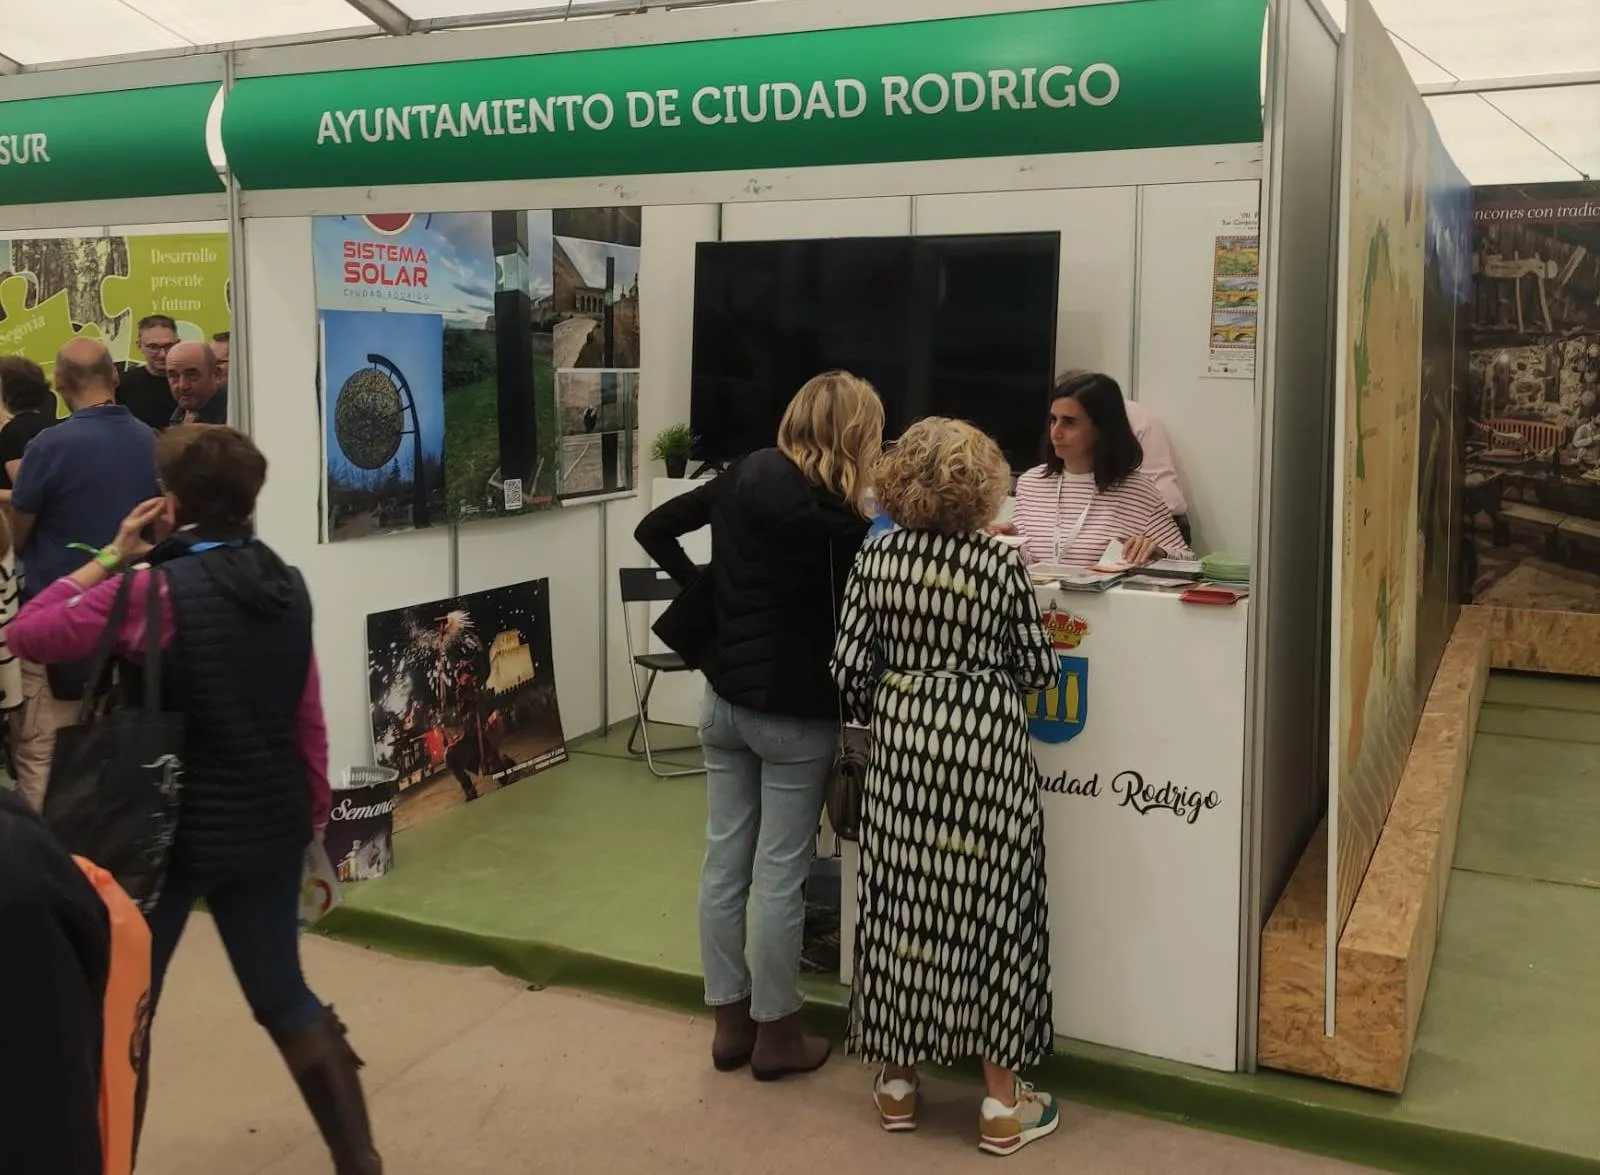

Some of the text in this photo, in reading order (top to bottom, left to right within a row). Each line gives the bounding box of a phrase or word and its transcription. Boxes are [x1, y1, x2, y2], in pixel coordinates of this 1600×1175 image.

[316, 63, 1121, 146] AYUNTAMIENTO DE CIUDAD RODRIGO
[0, 132, 50, 165] SUR
[1527, 207, 1554, 218] con
[151, 248, 217, 264] Desarrollo
[343, 240, 428, 265] SISTEMA
[151, 273, 205, 292] presente
[343, 261, 428, 288] SOLAR
[161, 296, 202, 311] futuro
[343, 288, 430, 301] CIUDAD RODRIGO
[1111, 770, 1222, 824] Rodrigo
